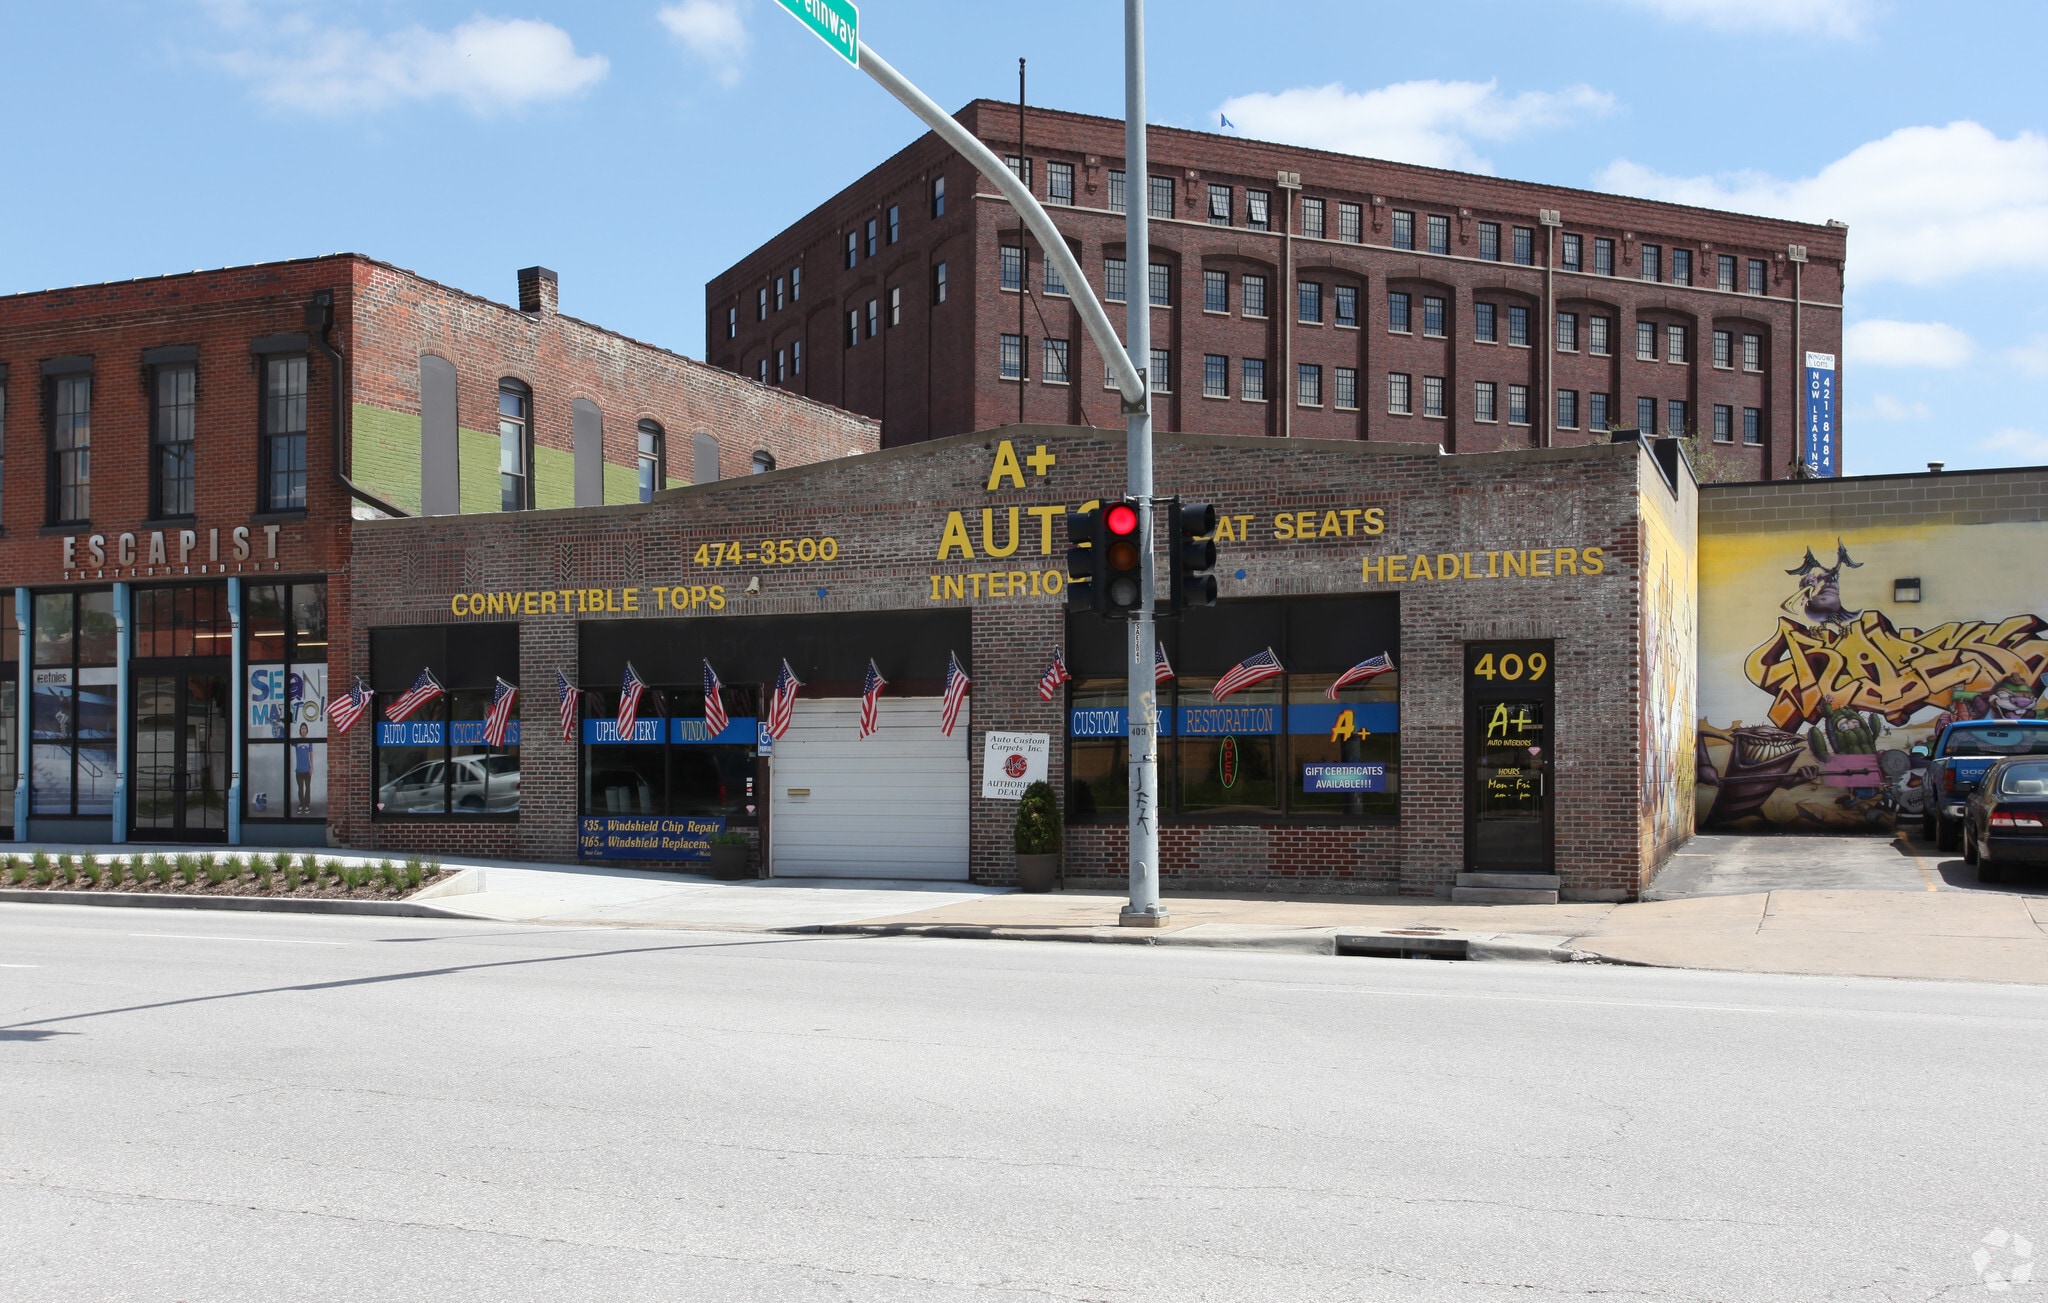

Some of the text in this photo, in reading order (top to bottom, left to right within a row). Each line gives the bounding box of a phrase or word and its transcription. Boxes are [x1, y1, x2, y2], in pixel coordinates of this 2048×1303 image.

[796, 0, 855, 57] ennway
[1811, 371, 1820, 399] NOW
[987, 440, 1055, 490] A+
[937, 500, 1100, 560] AUT
[1274, 508, 1385, 540] SEATS
[63, 524, 280, 569] ESCAPIST
[694, 537, 838, 567] 474-3500
[64, 561, 280, 580] SKATEBOARDING
[1362, 547, 1604, 583] HEADLINERS
[930, 571, 1086, 599] INTERIO
[451, 585, 726, 616] CONVERTIBLE TOPS
[1474, 652, 1548, 681] 409
[1074, 711, 1119, 735] CUSTOM
[1131, 727, 1147, 736] 409
[1186, 708, 1274, 733] RESTORATION
[1331, 709, 1371, 742] A+
[1488, 702, 1533, 738] A+
[383, 723, 441, 744] AUTO GLASS
[453, 725, 482, 743] CYCLE
[990, 736, 1046, 745] Auto Custom
[991, 743, 1043, 753] Carpets Inc.
[986, 780, 1031, 789] AUTHORIZ
[1305, 766, 1383, 777] GIFT CERTIFICATES
[1315, 779, 1372, 789] AVAILABLE!!!
[607, 819, 659, 832] Windshield
[661, 820, 684, 834] Chip
[687, 820, 720, 834] Repair
[608, 836, 659, 848] Windshield
[661, 837, 711, 851] Replacem
